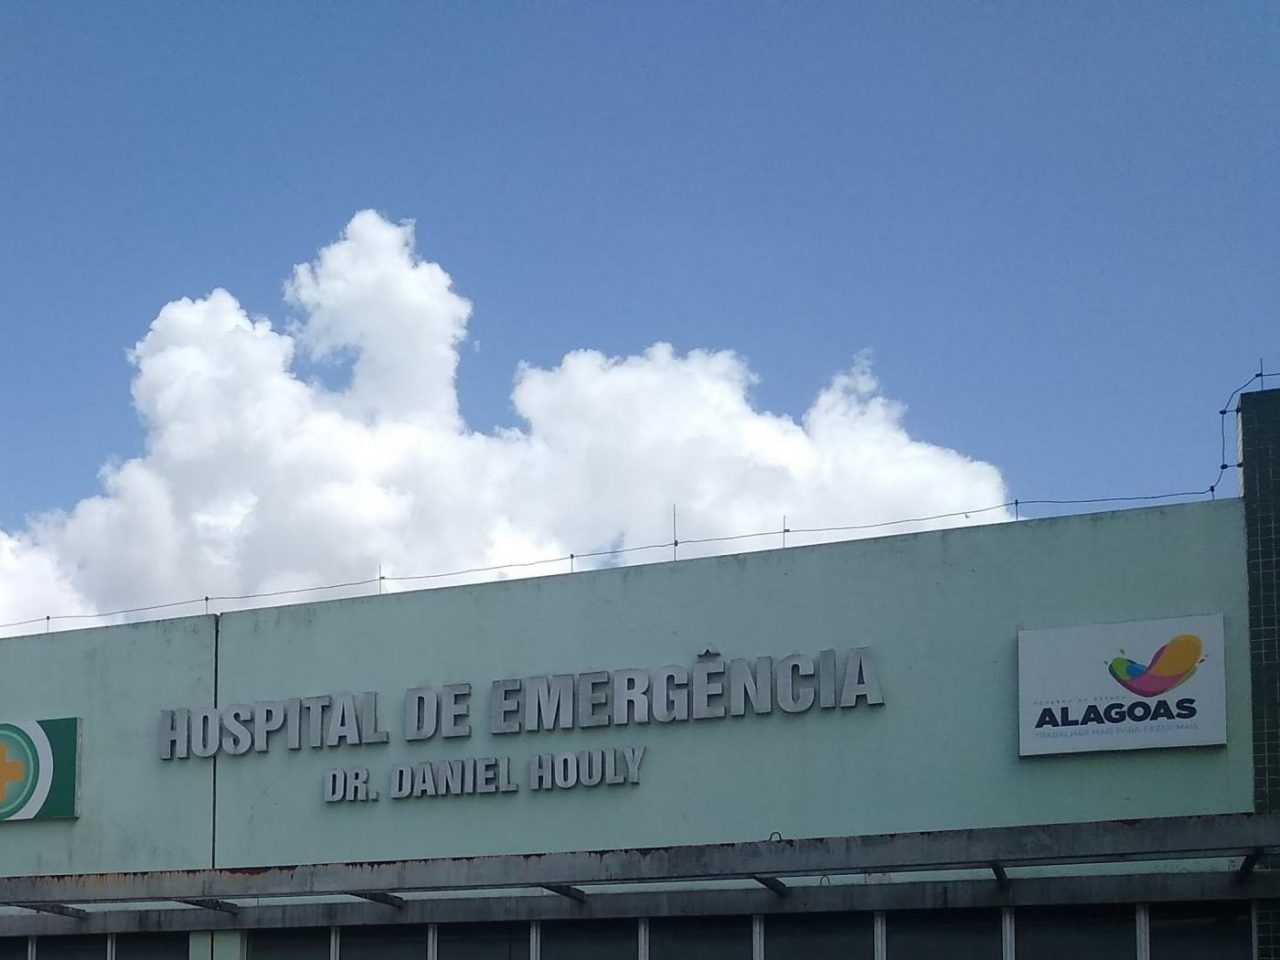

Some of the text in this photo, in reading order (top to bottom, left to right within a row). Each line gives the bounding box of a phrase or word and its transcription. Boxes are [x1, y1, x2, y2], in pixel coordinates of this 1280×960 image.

[159, 642, 885, 761] HOSPITAL DE EMERGÊNCIA
[1035, 698, 1198, 728] ALAGOAS
[324, 745, 647, 803] DR. DANIEL HOULY
